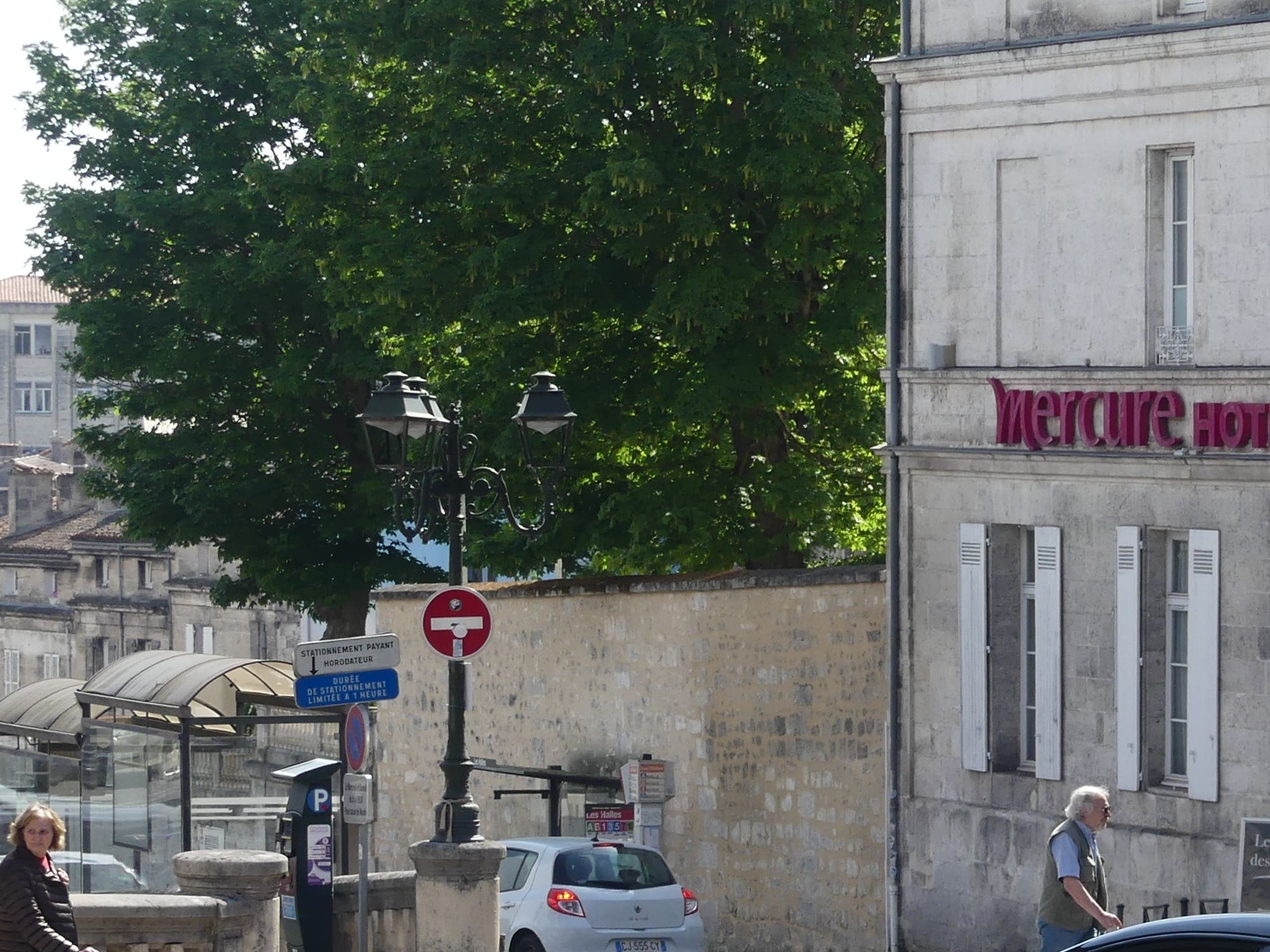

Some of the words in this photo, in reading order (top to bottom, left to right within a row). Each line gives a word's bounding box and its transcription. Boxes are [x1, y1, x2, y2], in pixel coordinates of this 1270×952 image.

[301, 644, 363, 658] STATIONNEMENT
[366, 641, 394, 651] PAYANT
[323, 655, 374, 667] HORODATEUR
[332, 675, 360, 685] DURÉE
[307, 688, 318, 696] DE
[320, 681, 386, 694] STATIONNEMENT
[308, 693, 341, 704] LIMITÉE
[360, 689, 387, 699] HEURE
[314, 788, 329, 812] P
[586, 811, 599, 819] Les
[600, 810, 621, 819] Halles
[587, 822, 593, 831] A
[594, 822, 600, 831] B
[602, 822, 606, 831] 1
[614, 822, 620, 831] 5
[1249, 853, 1270, 867] des
[621, 941, 660, 952] CJ-555-CY
